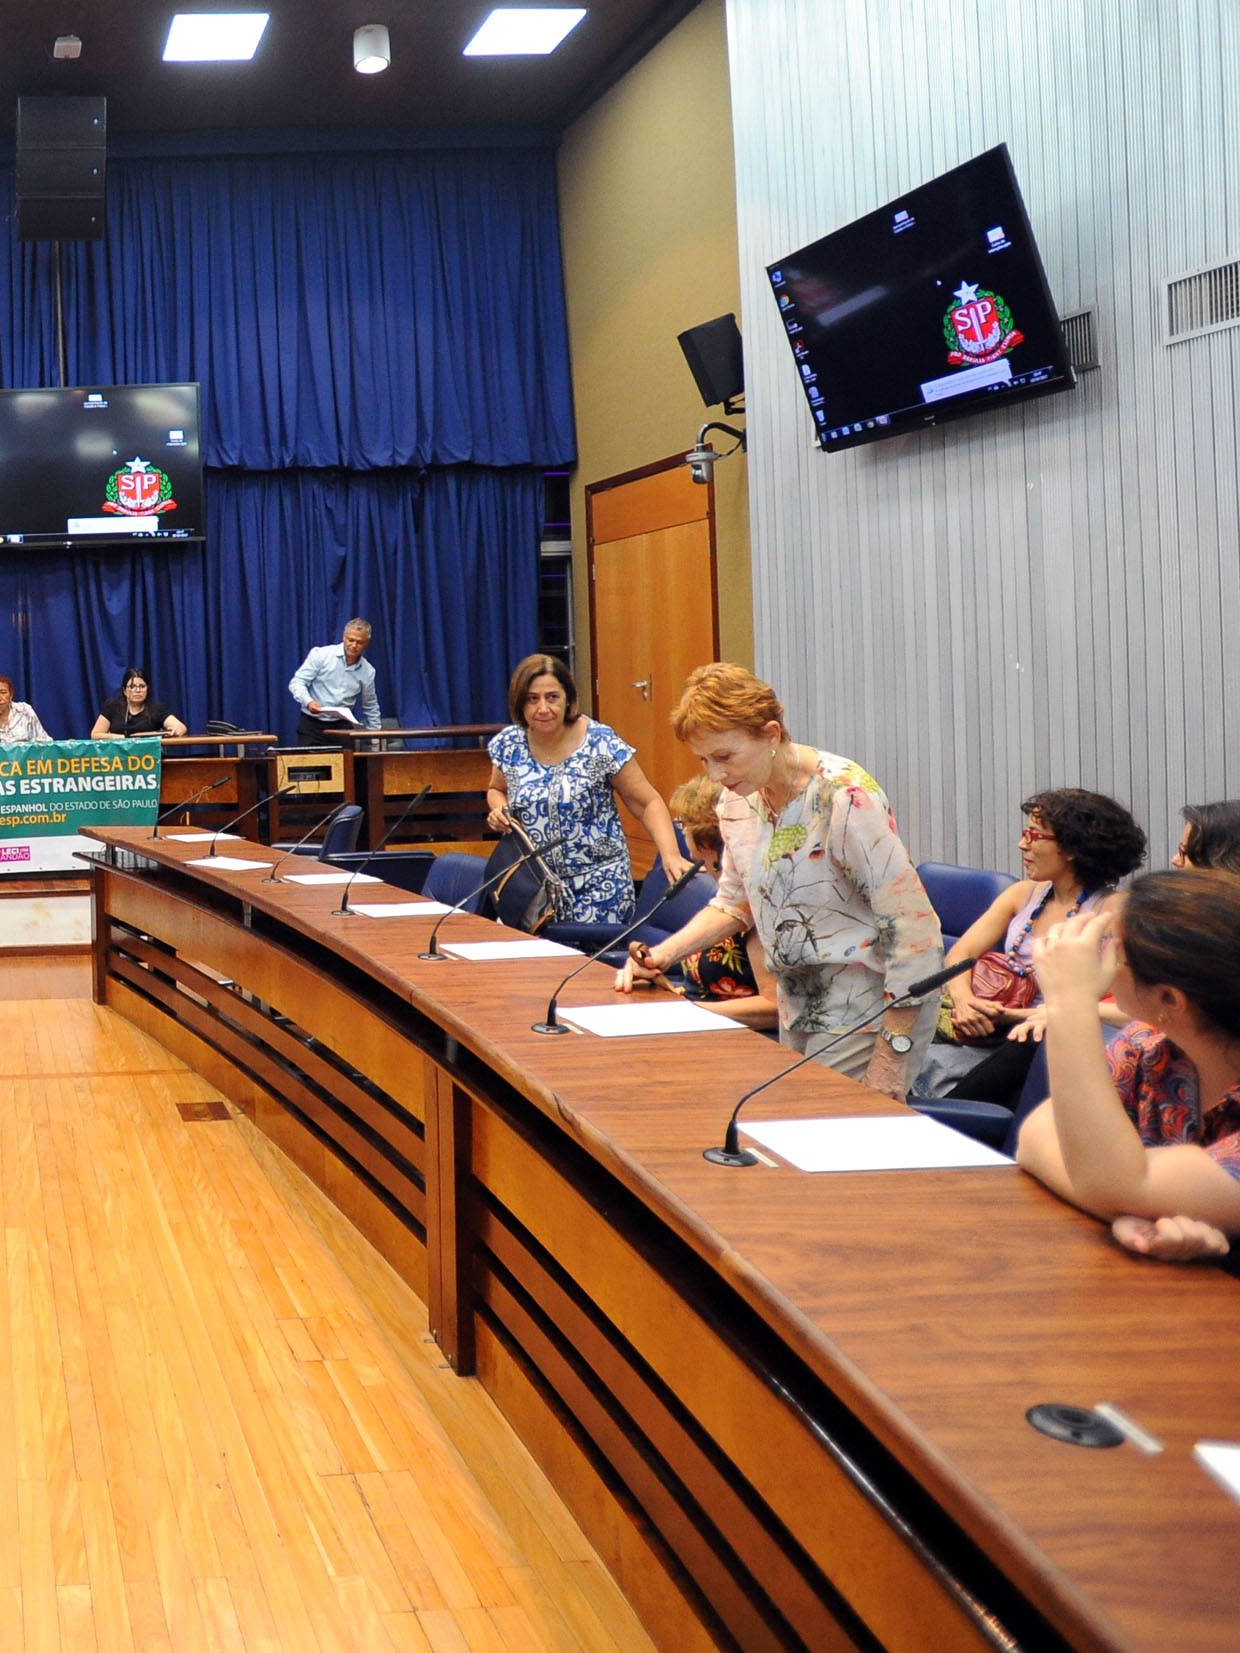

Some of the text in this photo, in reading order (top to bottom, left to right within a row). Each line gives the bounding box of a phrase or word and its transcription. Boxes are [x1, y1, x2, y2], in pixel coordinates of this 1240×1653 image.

[26, 759, 53, 776] EM
[57, 756, 124, 774] DEFESA
[127, 754, 155, 771] DO
[20, 774, 158, 795] ESTRANGEIRAS
[0, 803, 48, 815] ESPANHOL
[49, 802, 63, 812] DO
[65, 801, 98, 811] ESTADO
[99, 800, 111, 810] DE
[112, 798, 130, 809] SÃO
[132, 799, 158, 809] PAULO
[1, 847, 20, 856] LECI
